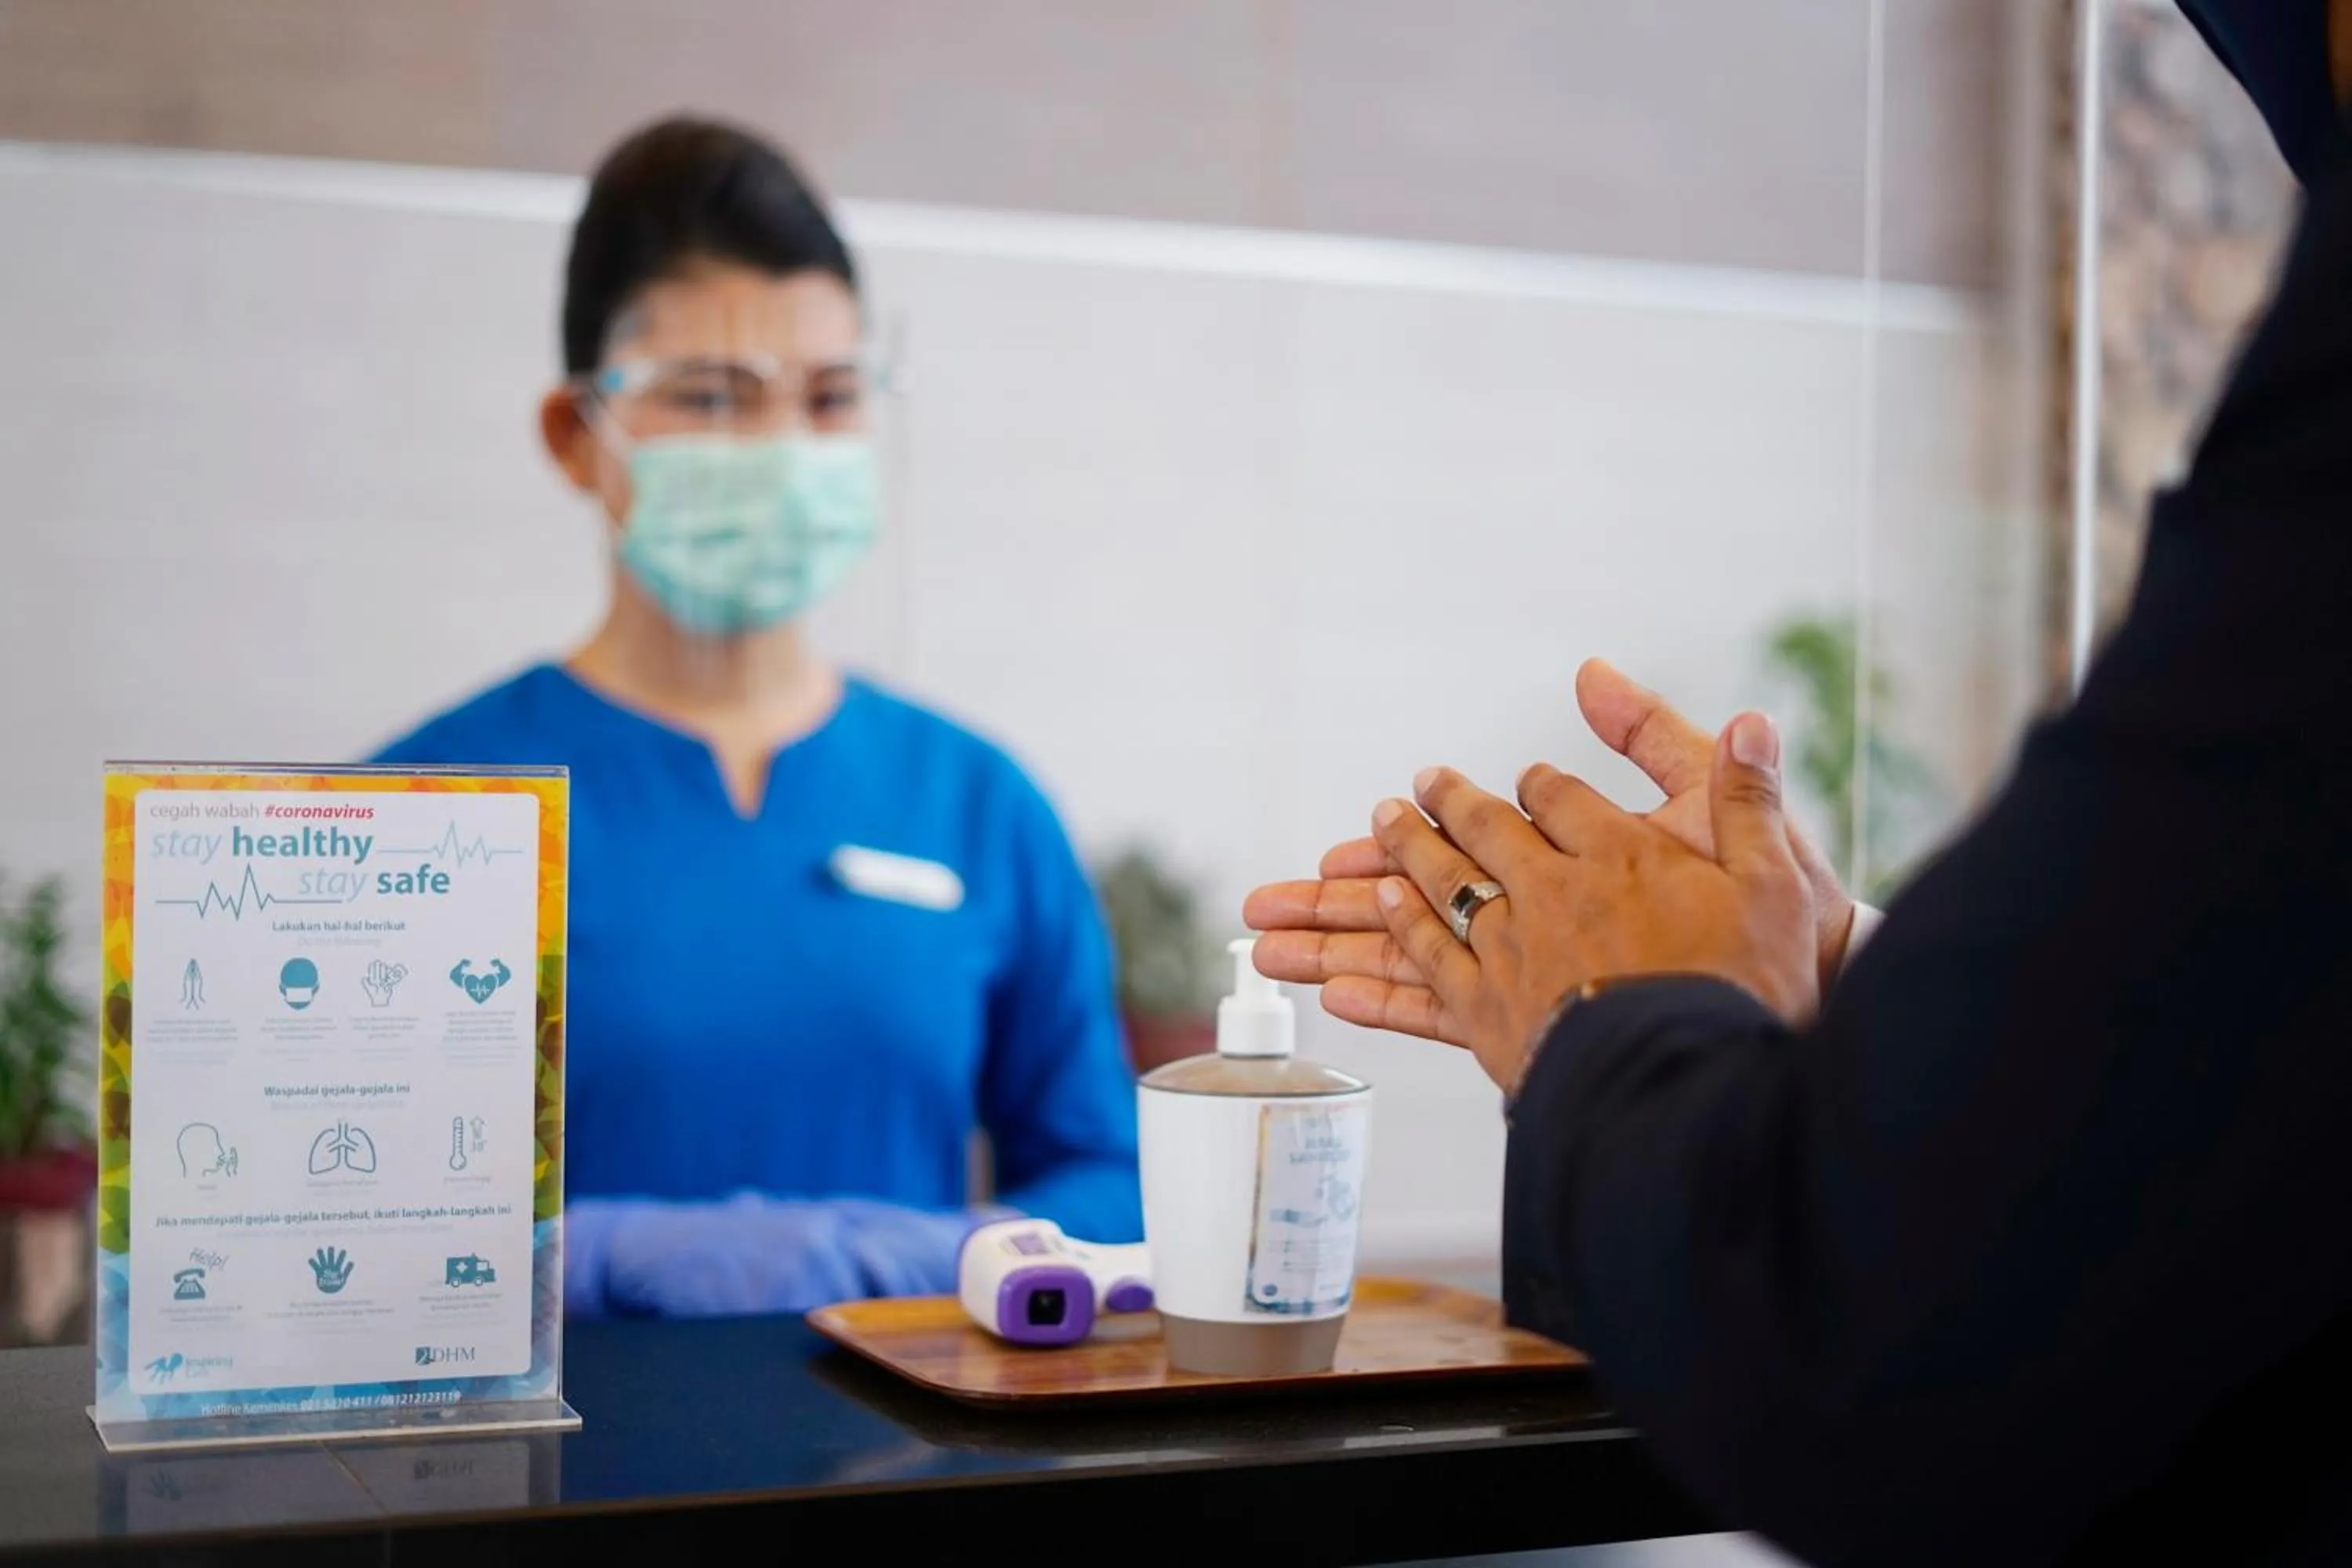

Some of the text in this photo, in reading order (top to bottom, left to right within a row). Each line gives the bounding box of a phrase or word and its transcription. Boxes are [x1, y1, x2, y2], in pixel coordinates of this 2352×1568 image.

[150, 803, 375, 820] cegah wabah #coronavirus
[151, 826, 374, 864] stay healthy
[299, 864, 450, 900] stay safe
[272, 920, 406, 931] Lakukan hal-hal berikut
[264, 1083, 411, 1098] Waspadai gejala-gejala ini
[246, 1211, 319, 1226] gejala-gejala
[374, 1209, 399, 1218] ikuti
[402, 1206, 495, 1220] langkah-langkah
[498, 1204, 511, 1215] ini
[433, 1347, 475, 1363] DHM
